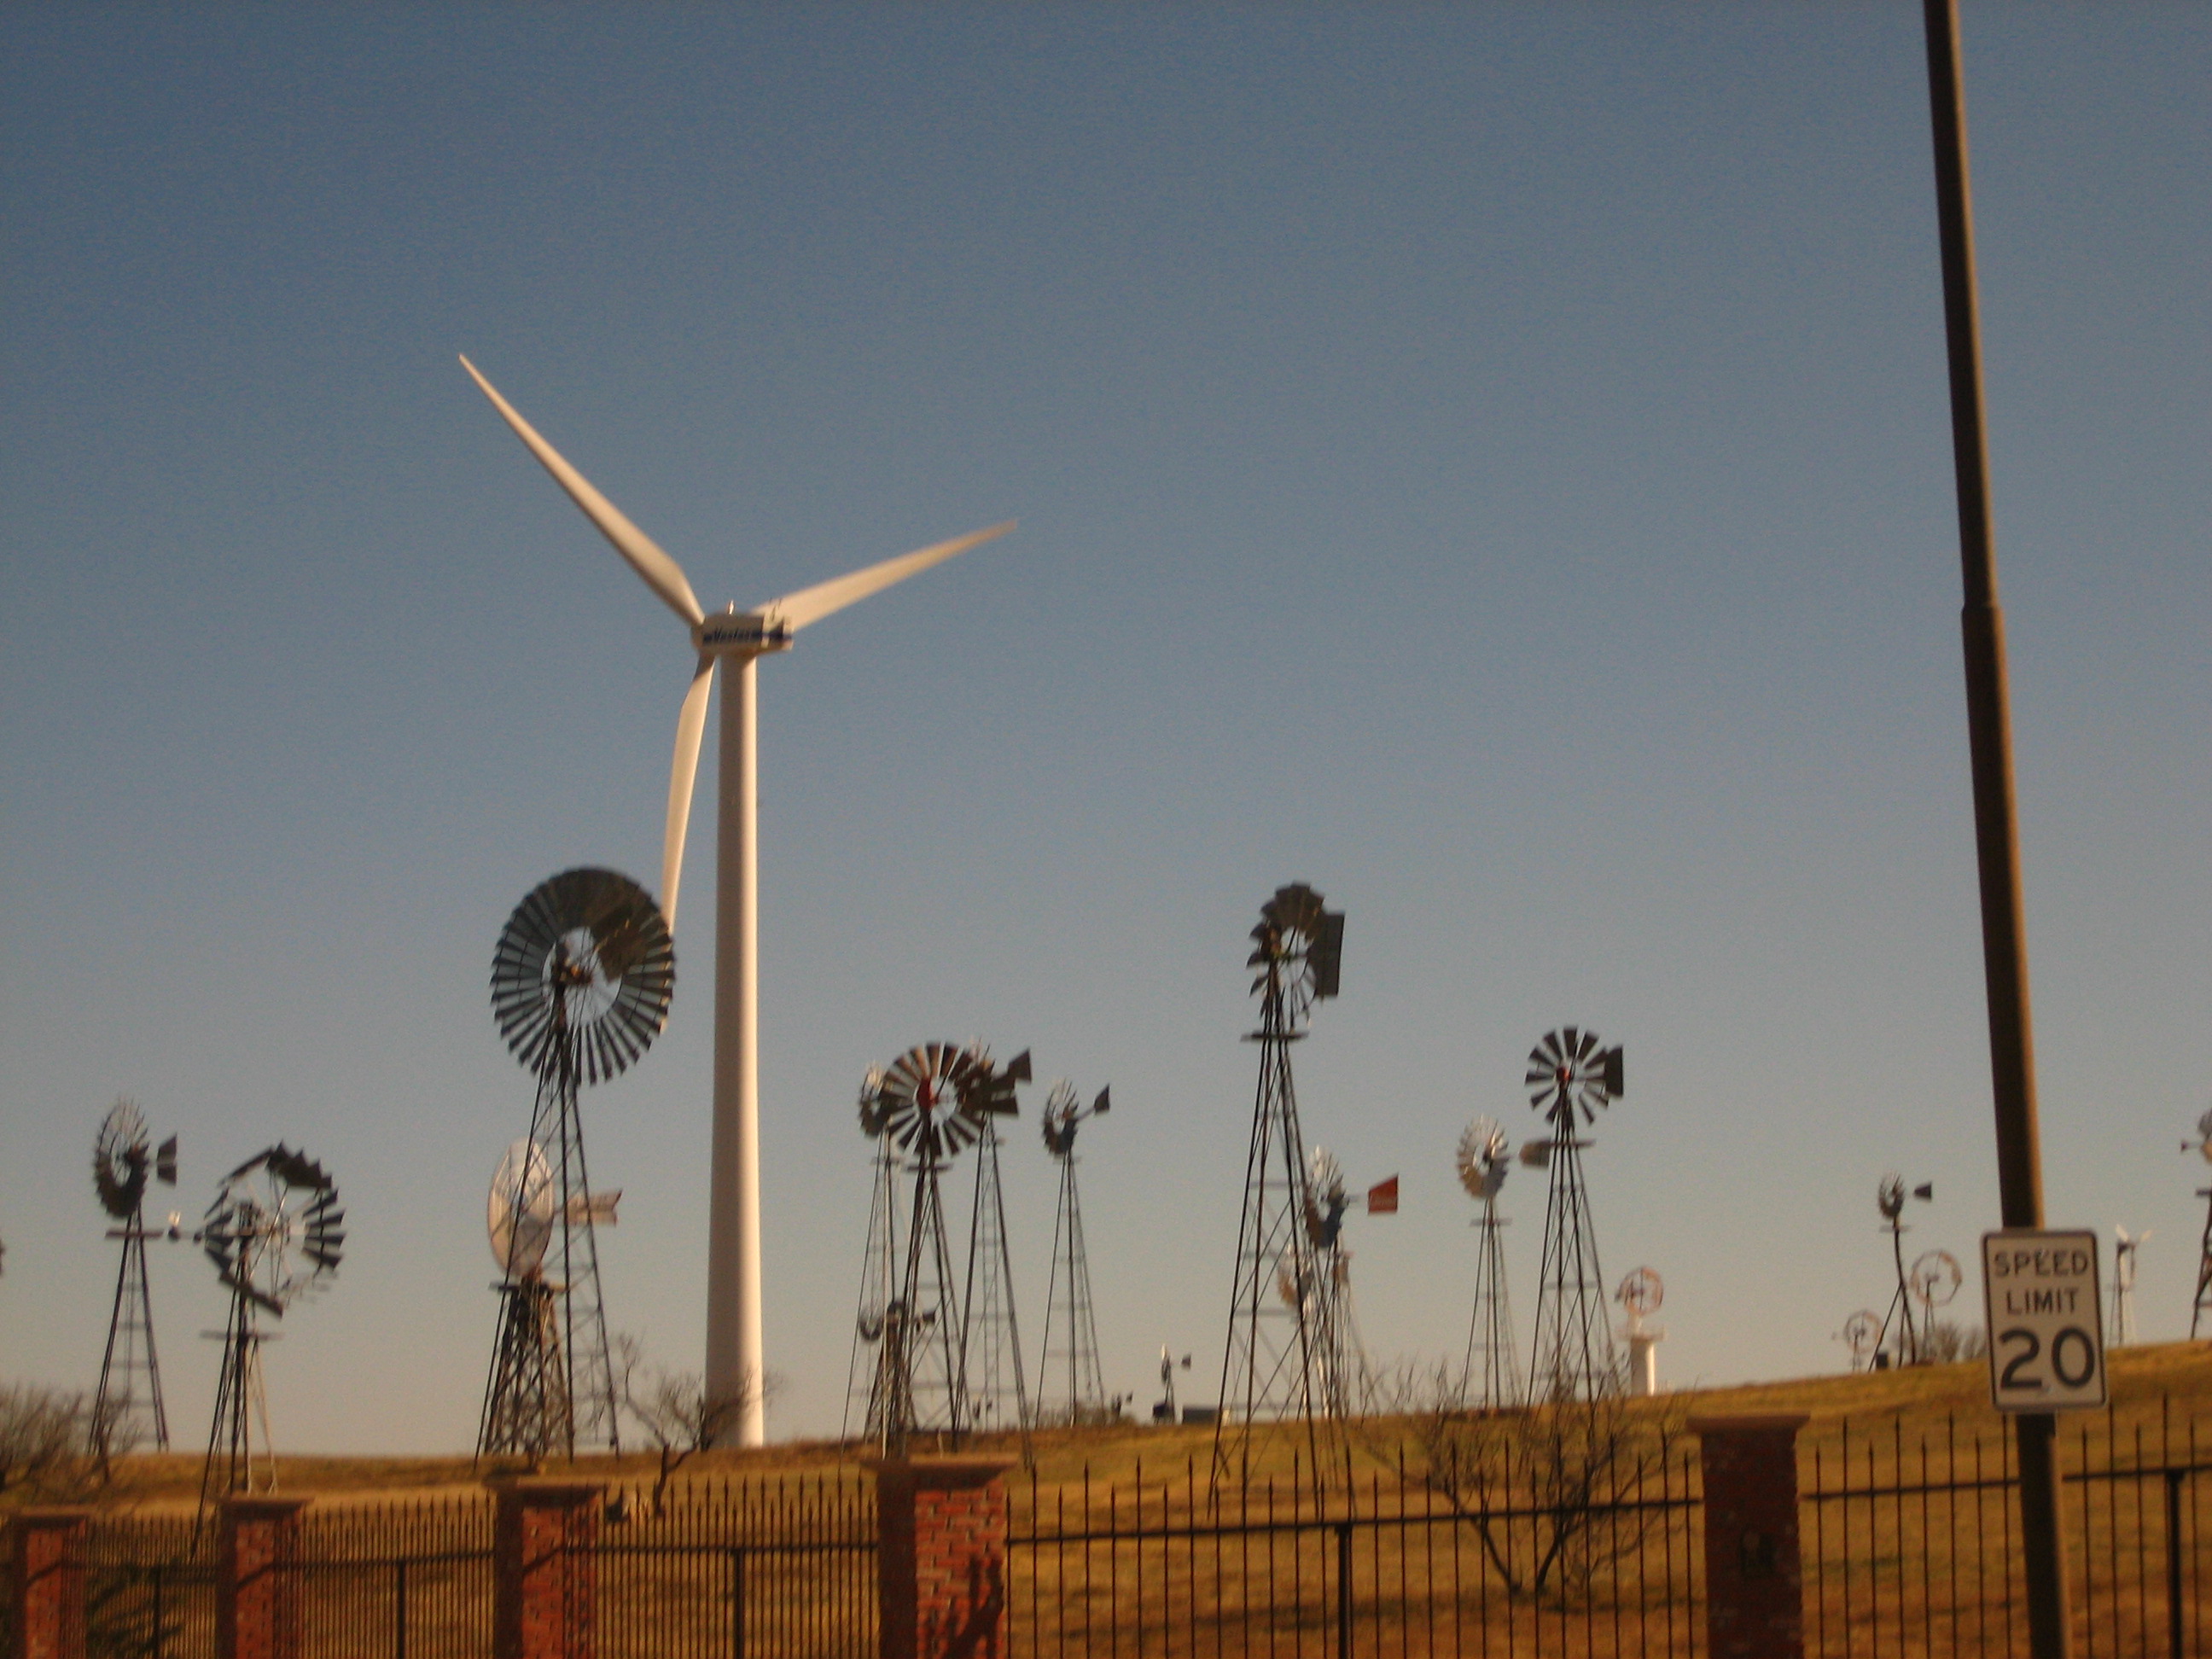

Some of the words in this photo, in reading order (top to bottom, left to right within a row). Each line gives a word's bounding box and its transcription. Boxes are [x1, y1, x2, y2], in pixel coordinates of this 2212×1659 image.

[1994, 1251, 2088, 1277] SPEED
[2006, 1288, 2079, 1314] LIMIT
[2000, 1328, 2095, 1389] 20
